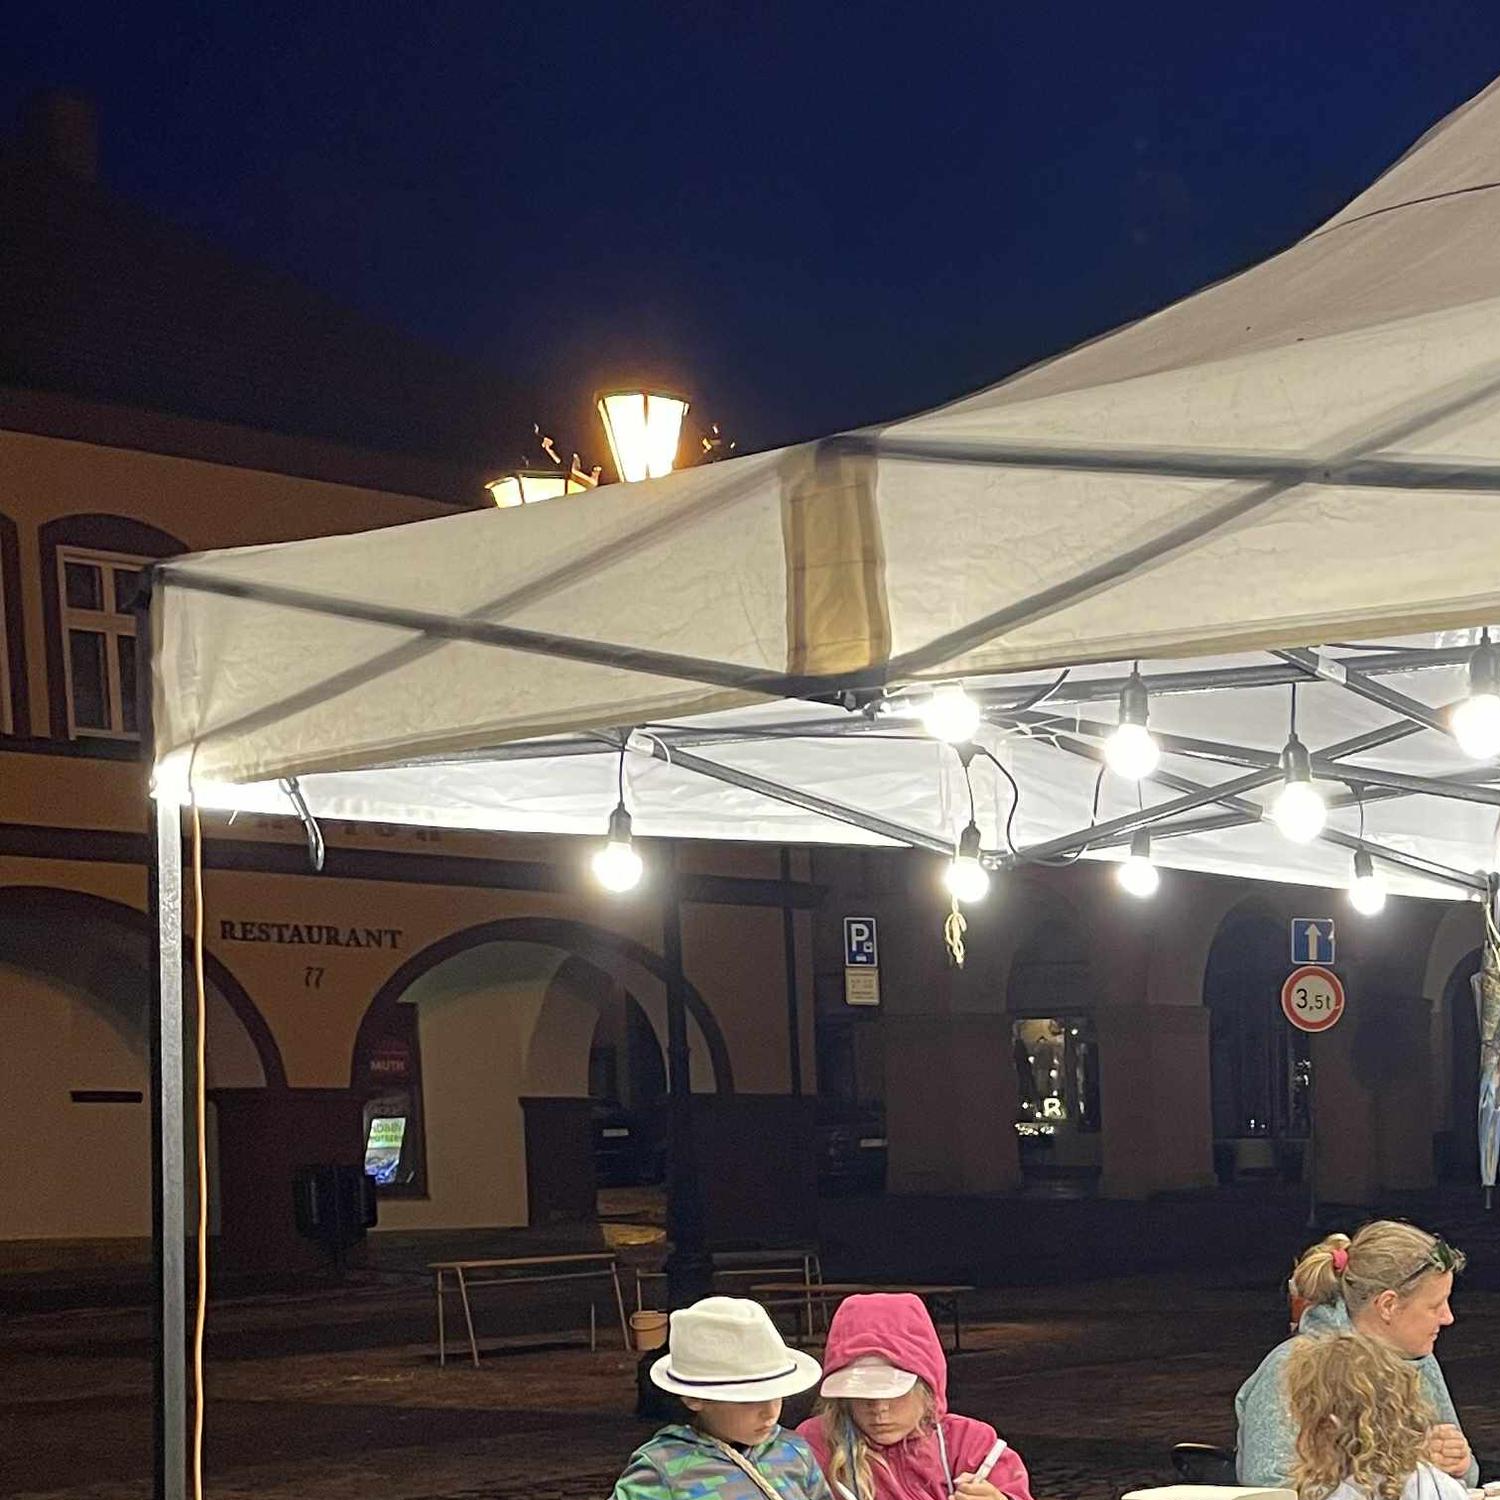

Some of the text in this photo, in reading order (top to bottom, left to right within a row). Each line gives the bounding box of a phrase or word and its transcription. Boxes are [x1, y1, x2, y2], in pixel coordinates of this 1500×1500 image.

[220, 920, 404, 949] RESTAURANT
[851, 923, 870, 952] P
[303, 966, 326, 989] 77
